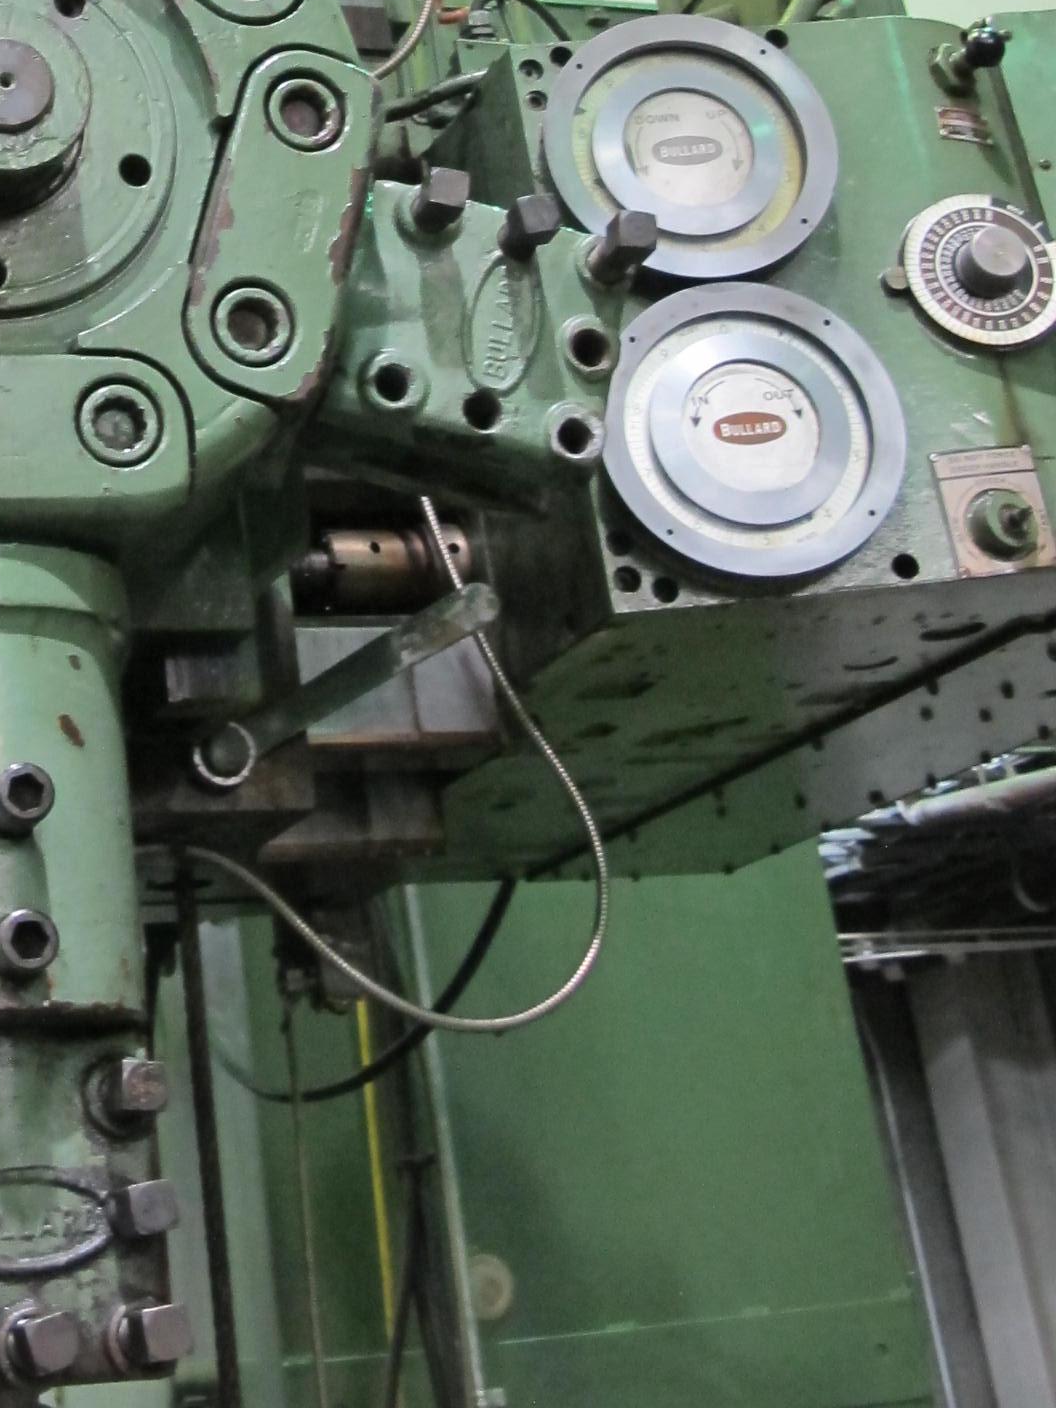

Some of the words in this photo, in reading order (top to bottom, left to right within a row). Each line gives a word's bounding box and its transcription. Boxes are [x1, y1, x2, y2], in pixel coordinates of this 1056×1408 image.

[634, 113, 680, 125] DOWN
[705, 109, 727, 120] UP
[659, 143, 716, 158] BULLARD
[690, 396, 709, 407] IN
[762, 388, 794, 401] OUT
[719, 421, 782, 437] BULLARD
